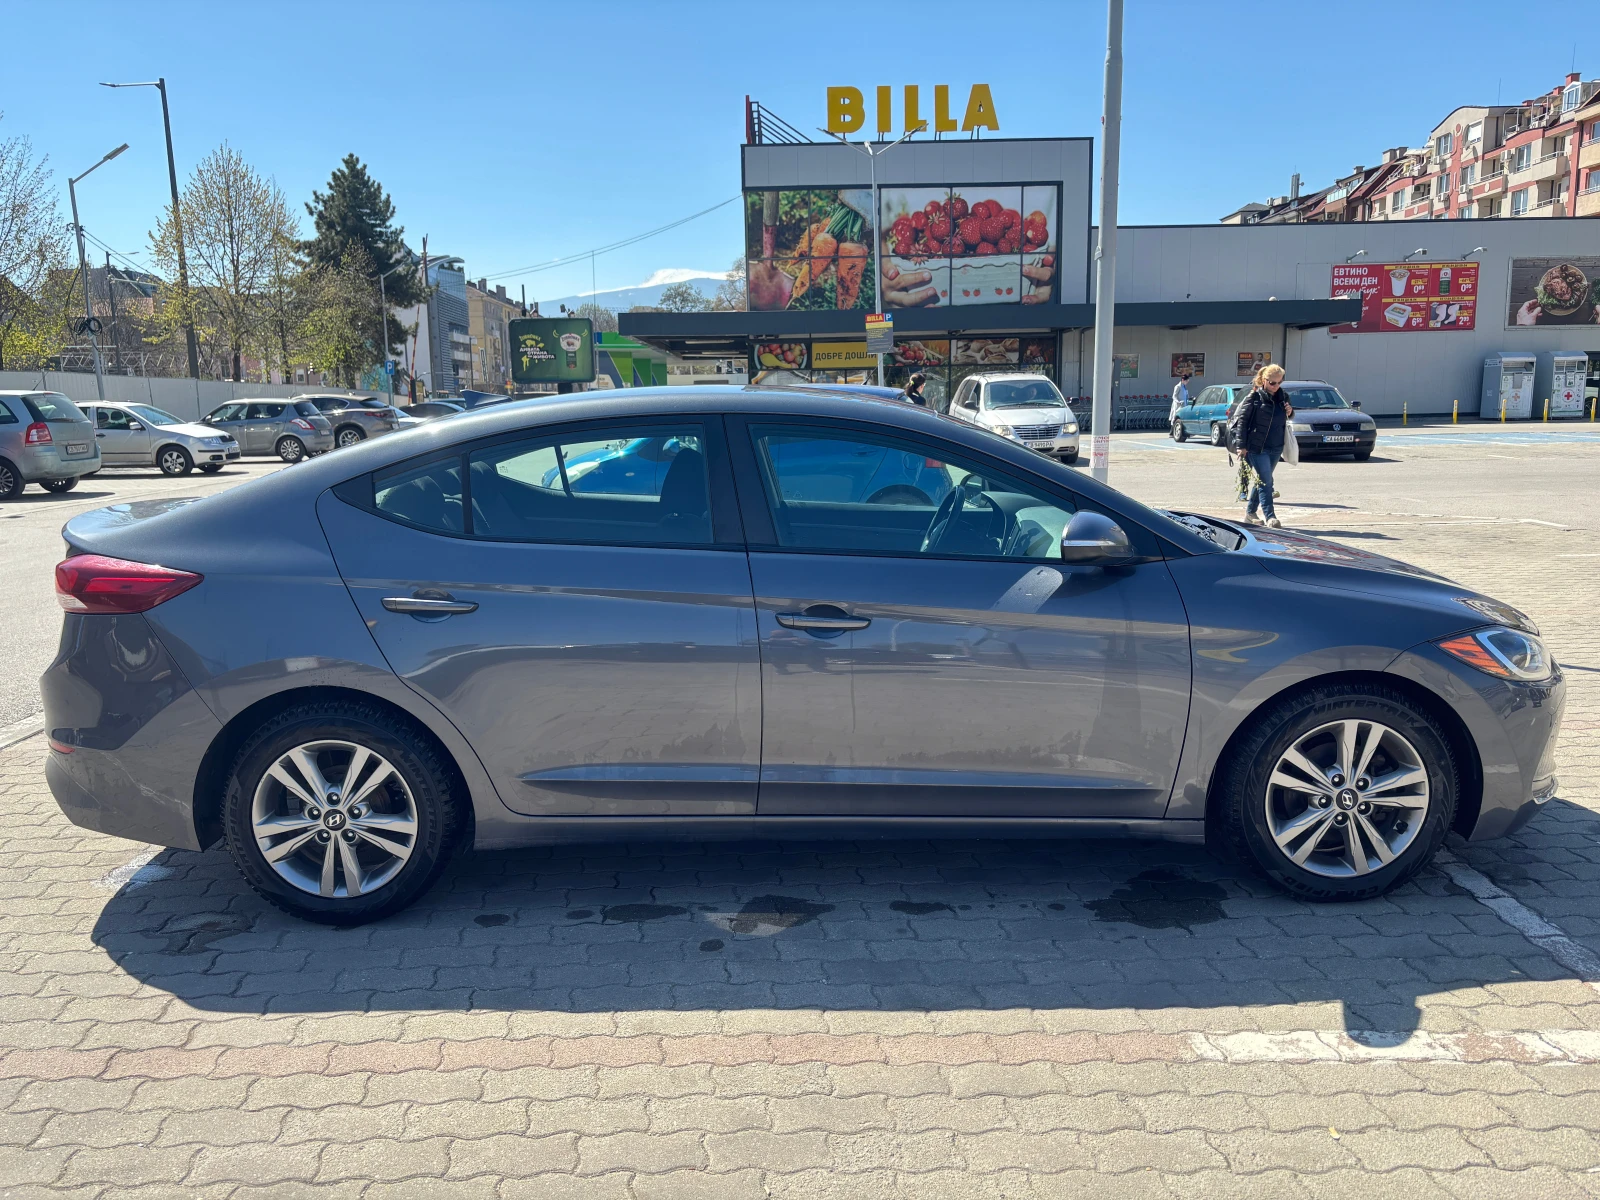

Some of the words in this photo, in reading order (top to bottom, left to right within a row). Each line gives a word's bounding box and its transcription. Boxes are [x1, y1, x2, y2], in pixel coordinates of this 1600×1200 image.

[827, 84, 1000, 133] BILLA
[1334, 267, 1368, 276] ЕВТИНО
[1334, 278, 1360, 286] ВСЕКИ
[1360, 276, 1378, 287] ДЕН
[815, 352, 843, 361] ДОБРЕ
[386, 362, 393, 373] P
